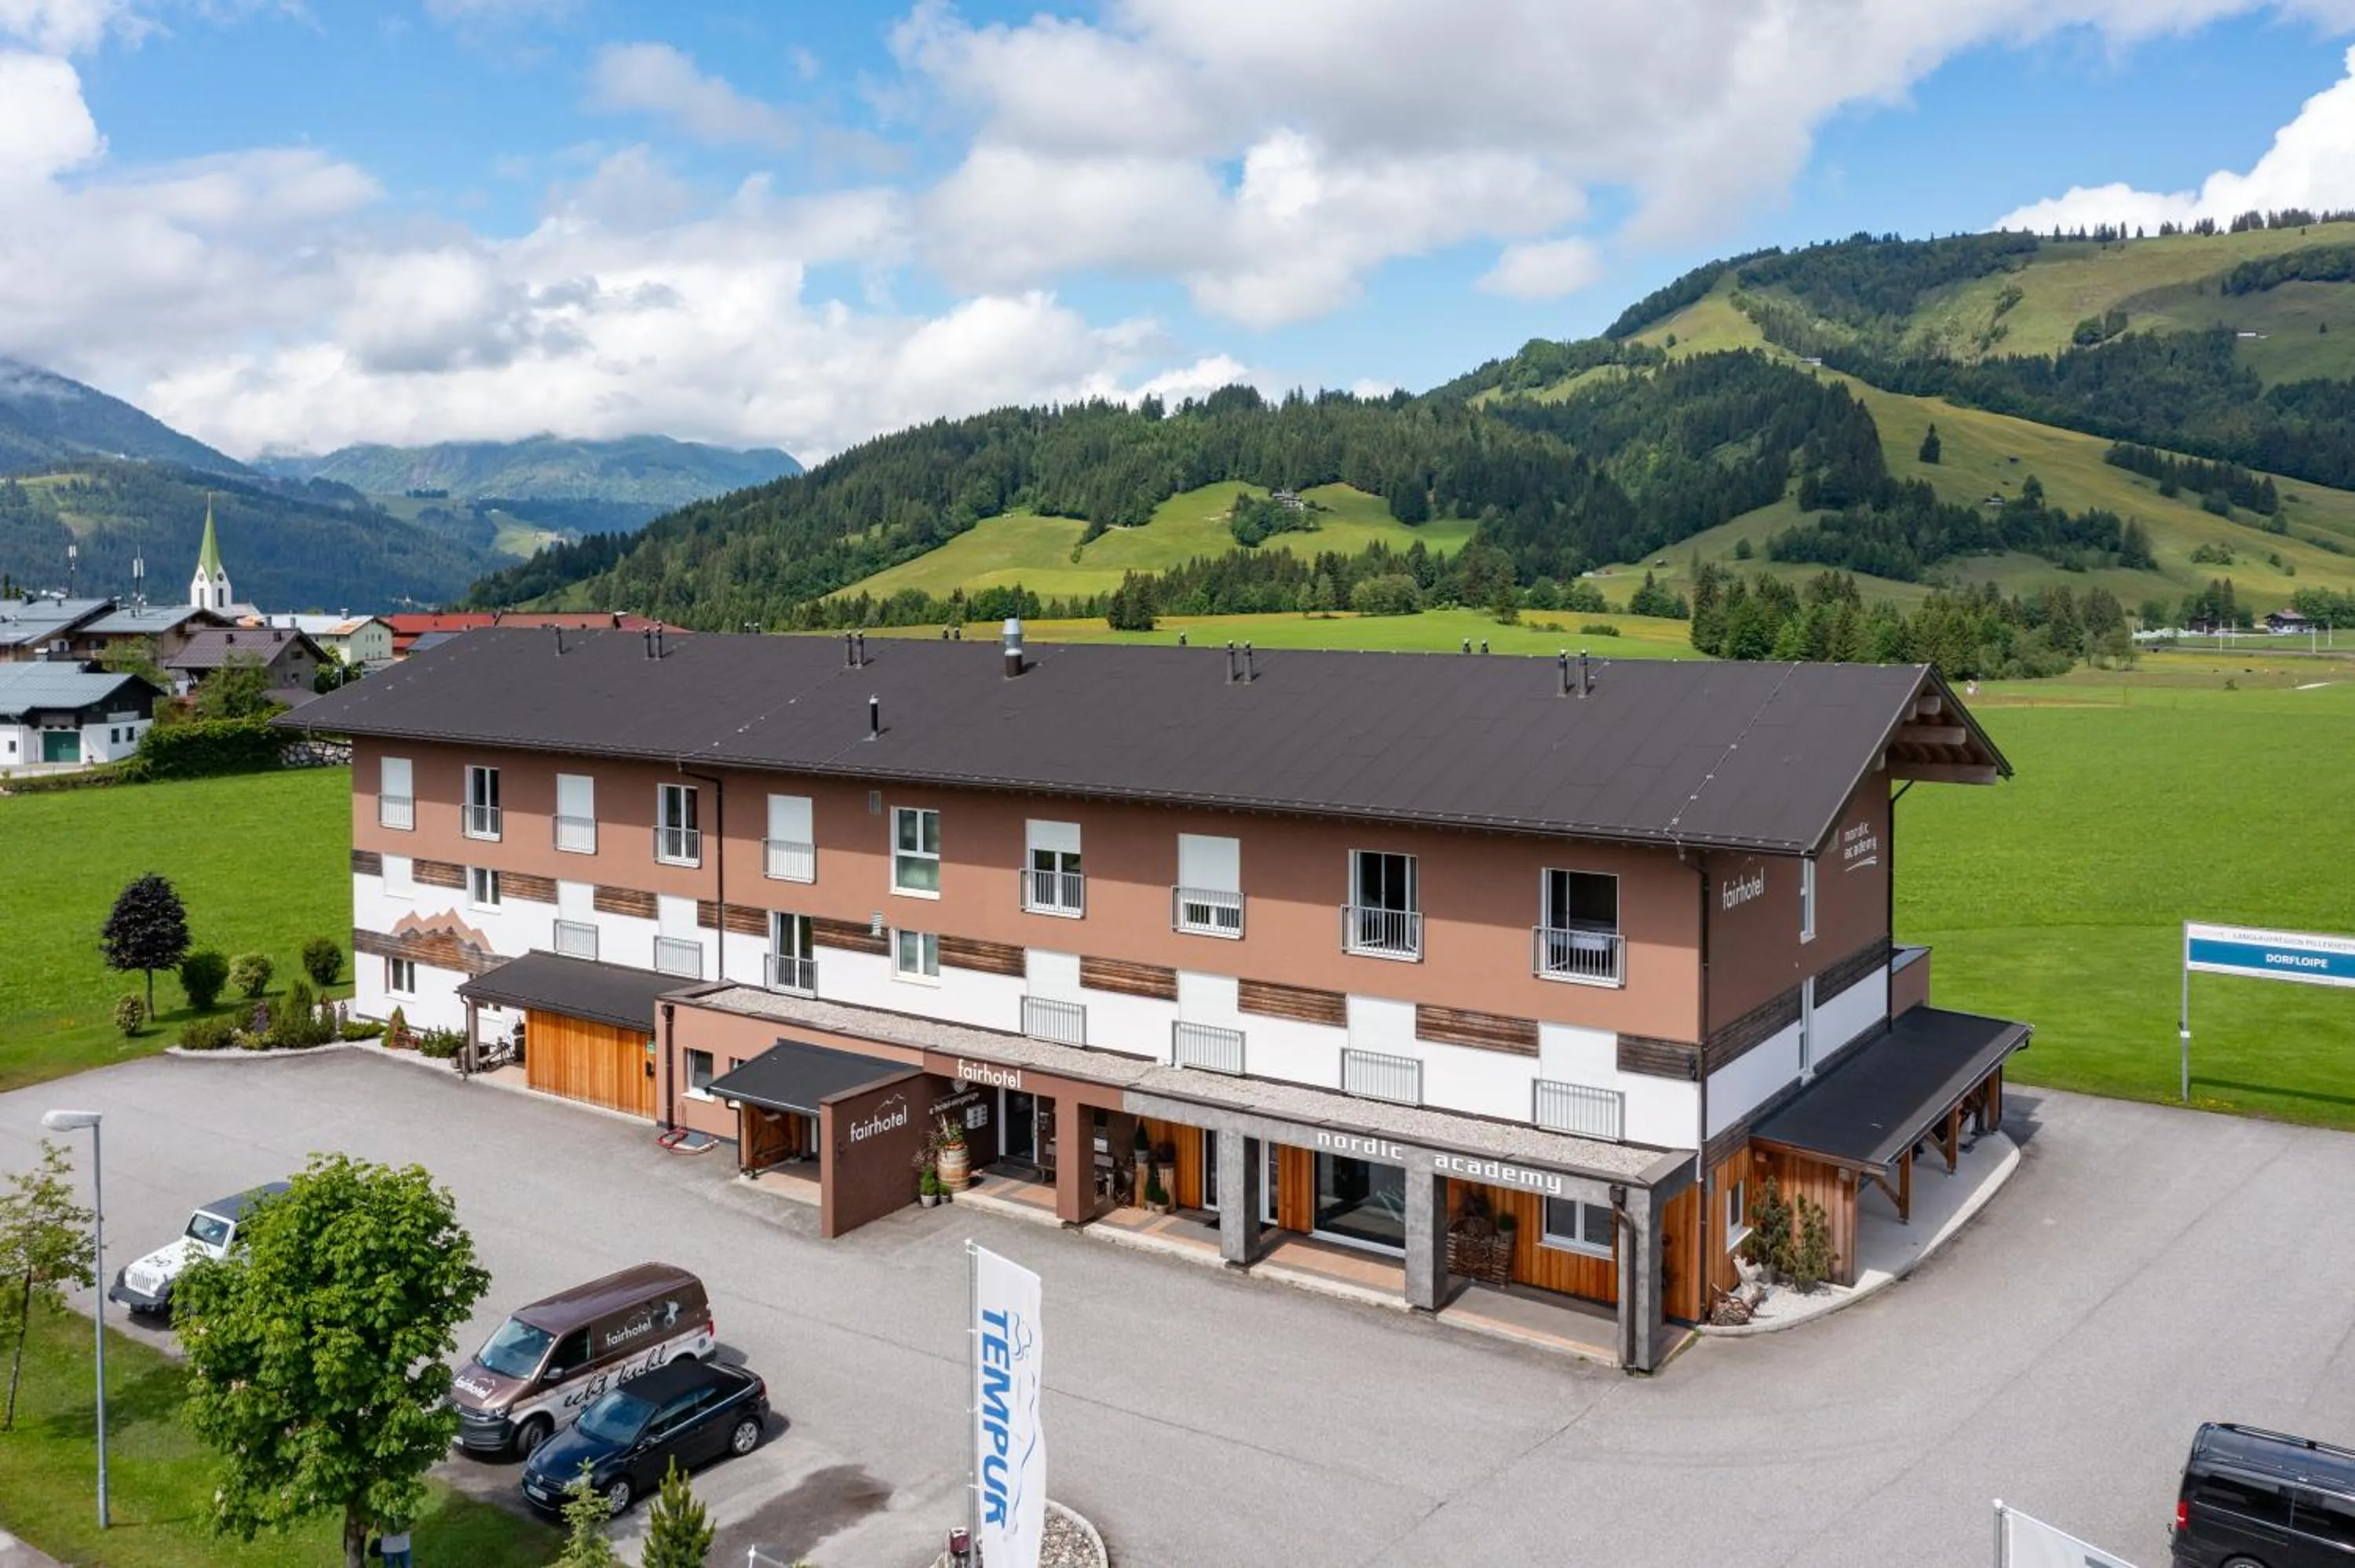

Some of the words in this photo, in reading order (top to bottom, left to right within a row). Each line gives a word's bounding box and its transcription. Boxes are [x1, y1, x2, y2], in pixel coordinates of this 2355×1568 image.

[1723, 866, 1764, 910] fairhotel
[2266, 954, 2328, 968] DORFLOIPE
[958, 1059, 1021, 1088] fairhotel
[850, 1104, 907, 1143] fairhotel
[1317, 1132, 1404, 1160] nordic
[1434, 1154, 1562, 1194] academy
[606, 1316, 652, 1347] fairhotel
[983, 1309, 1011, 1530] TEMPUR
